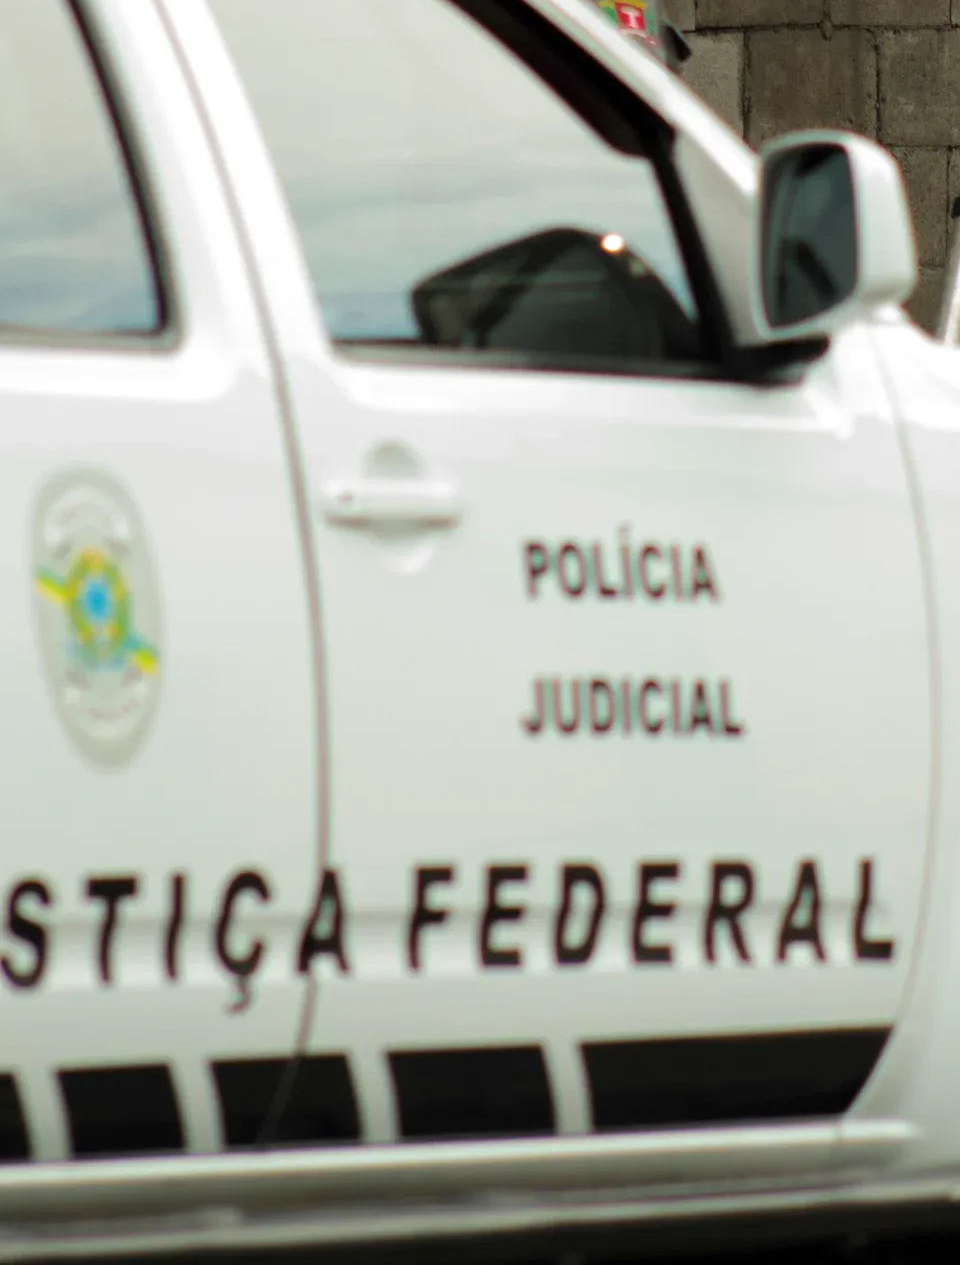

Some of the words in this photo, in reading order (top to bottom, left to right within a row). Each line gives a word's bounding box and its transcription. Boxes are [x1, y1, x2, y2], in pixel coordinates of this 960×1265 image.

[524, 523, 721, 601] POLÍCIA
[521, 677, 745, 738] JUDICIAL
[0, 868, 350, 1014] STIÇA
[407, 857, 897, 972] FEDERAL
